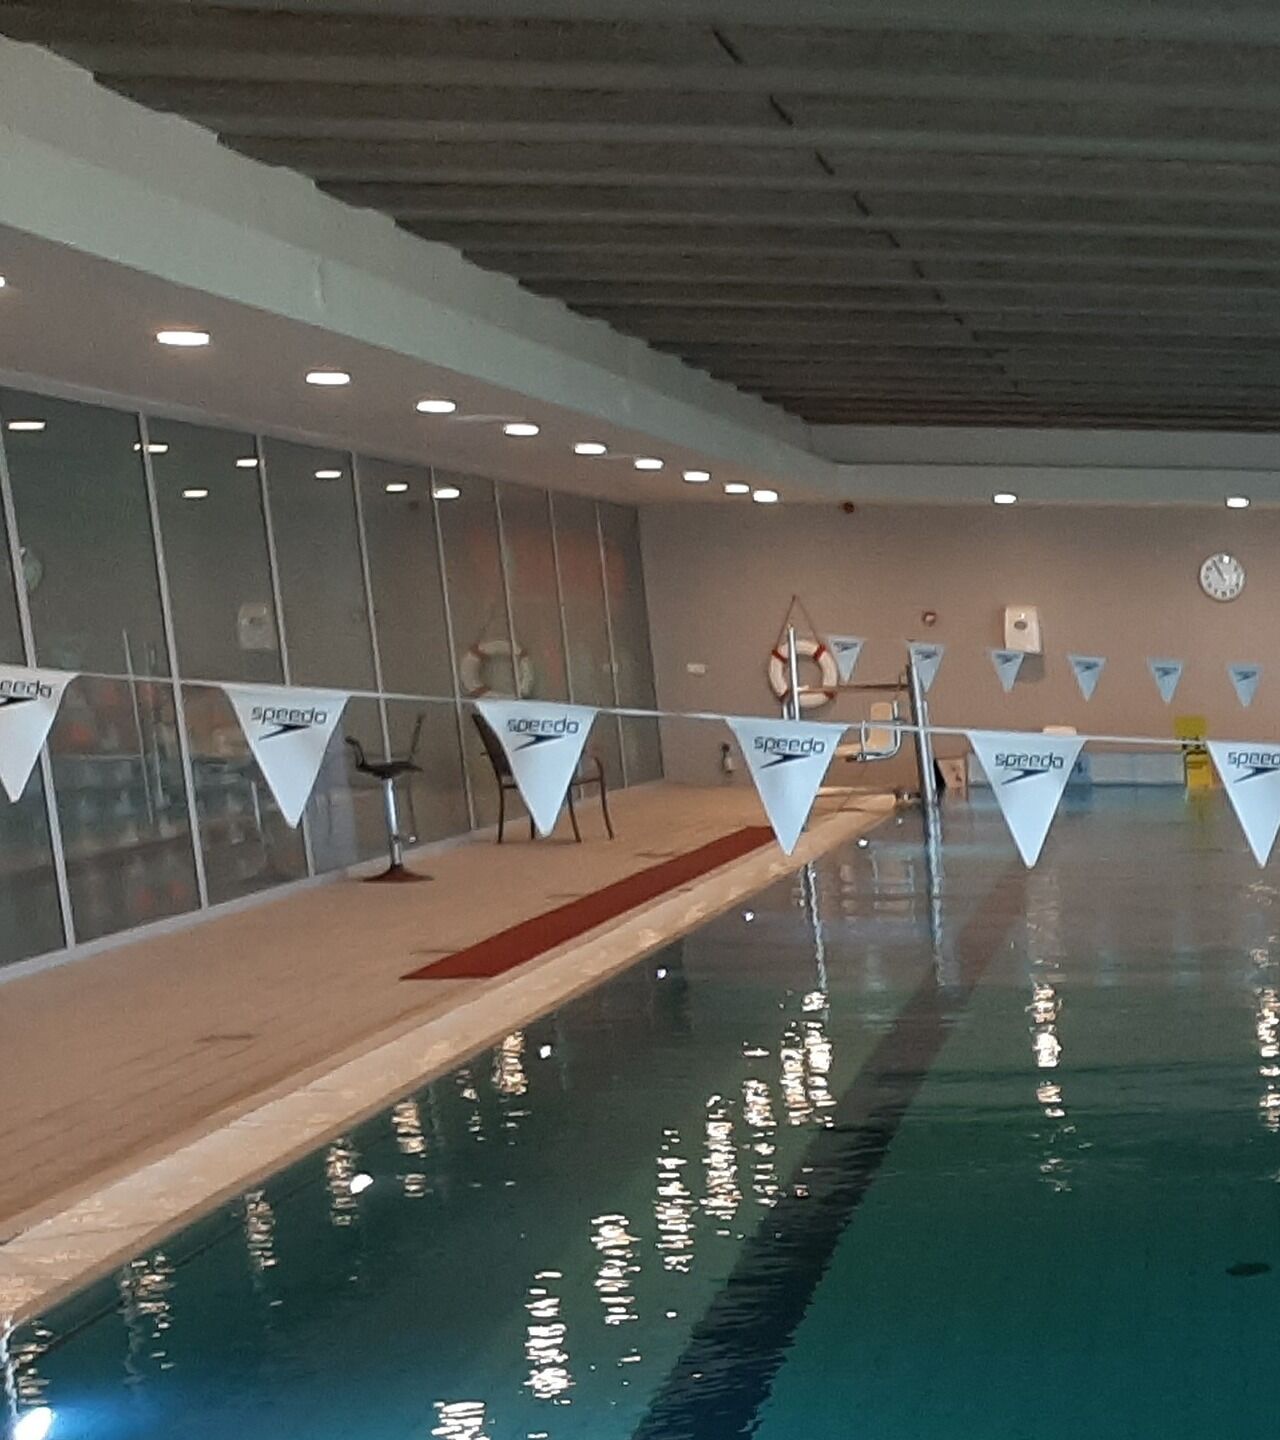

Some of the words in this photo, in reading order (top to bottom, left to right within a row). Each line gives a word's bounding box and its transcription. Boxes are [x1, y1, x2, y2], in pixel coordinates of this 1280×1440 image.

[251, 706, 327, 725] speedo
[507, 714, 580, 734] speedo
[753, 737, 825, 754] speedo
[994, 752, 1064, 769] speedo
